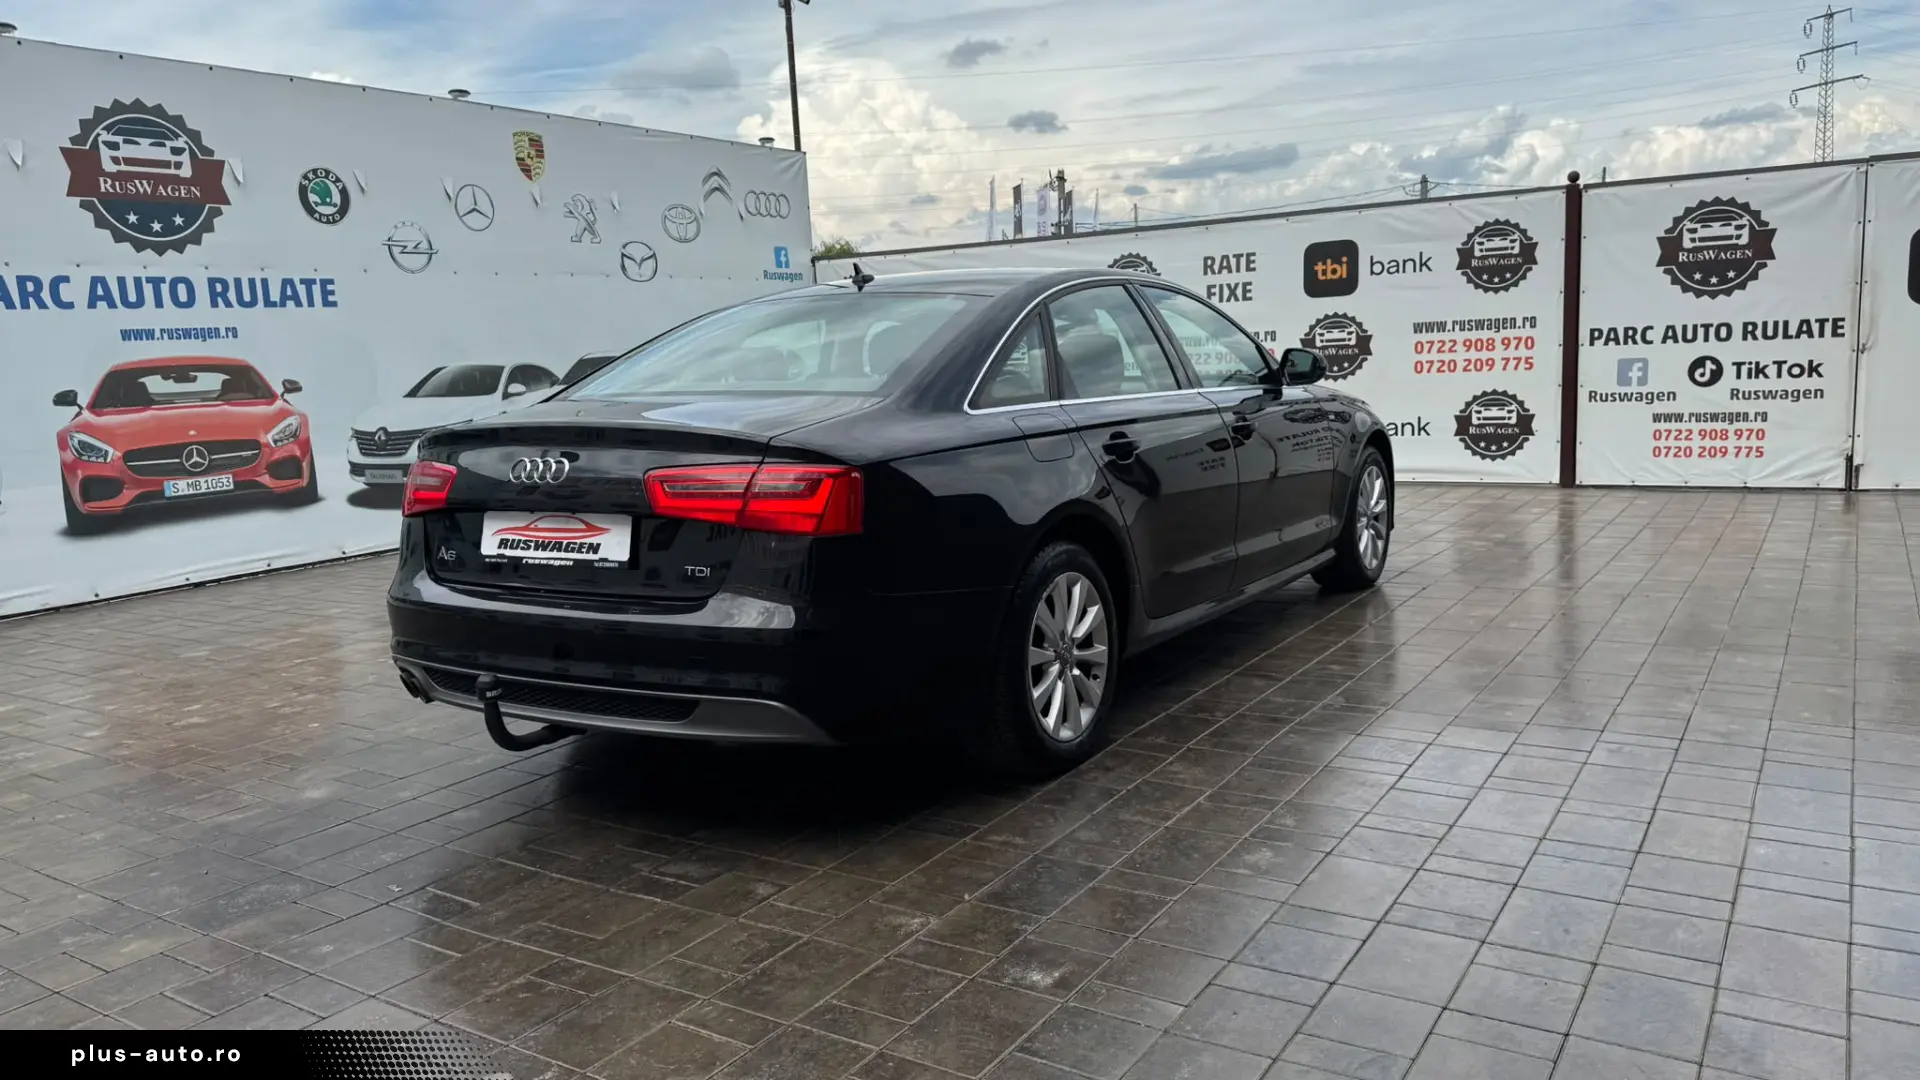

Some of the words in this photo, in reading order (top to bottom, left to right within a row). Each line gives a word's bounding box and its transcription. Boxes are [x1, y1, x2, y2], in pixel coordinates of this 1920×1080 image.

[313, 212, 341, 222] AUTO
[1202, 252, 1257, 276] RATE
[1313, 256, 1348, 281] tbi
[1369, 252, 1434, 277] bank
[763, 269, 804, 282] Ruswagen
[0, 275, 76, 310] ARC
[87, 275, 197, 309] AUTO
[207, 278, 339, 308] RULATE
[1206, 281, 1254, 303] FIXE
[120, 325, 239, 342] www.ruswagen.ro
[1412, 316, 1538, 336] www.ruswagen.ro
[1588, 325, 1655, 348] PARC
[1660, 322, 1734, 345] AUTO
[1741, 317, 1847, 341] RULATE
[1413, 341, 1458, 355] 0722
[1462, 339, 1497, 353] 908
[1500, 337, 1536, 351] 970
[1413, 360, 1458, 375] 0720
[1462, 358, 1497, 373] 209
[1500, 357, 1535, 371] 775
[1731, 360, 1825, 380] TikTok
[1588, 390, 1677, 405] Ruswagen
[1730, 388, 1825, 403] Ruswagen
[1386, 416, 1431, 437] ank
[1651, 412, 1769, 425] www.ruswagen.ro
[1652, 429, 1694, 442] 0722
[1698, 429, 1730, 442] 908
[1734, 428, 1766, 441] 970
[1652, 446, 1694, 459] 0720
[1698, 446, 1729, 459] 209
[1733, 445, 1765, 458] 775
[437, 545, 456, 560] A6
[497, 537, 602, 555] RUSWAGEN
[522, 558, 574, 566] ruswagen
[684, 565, 711, 577] TDI
